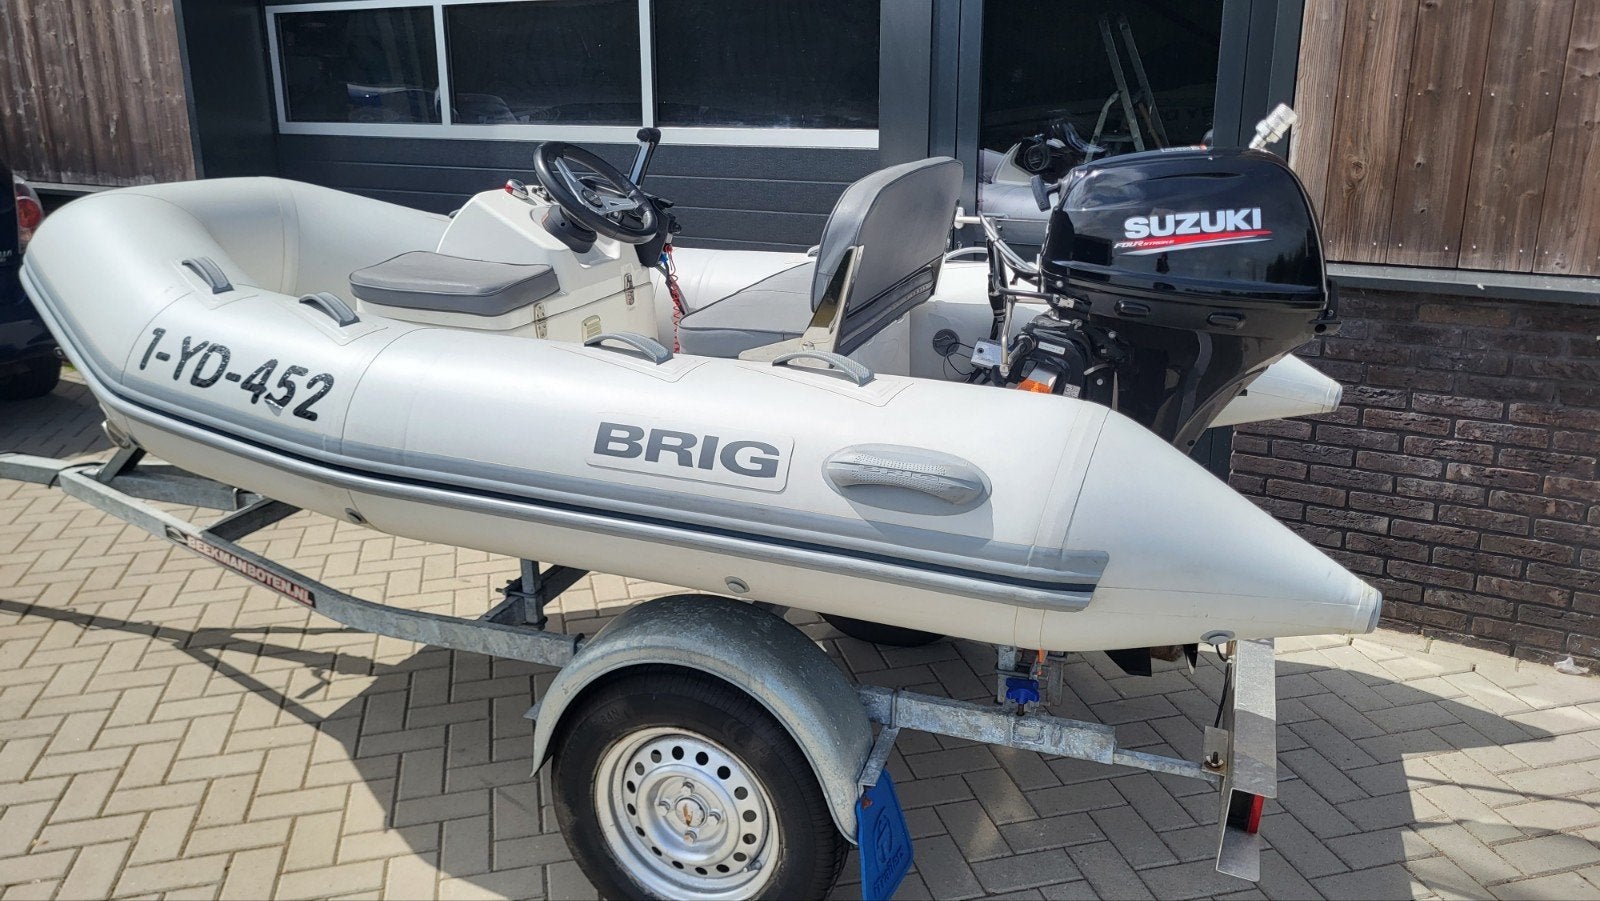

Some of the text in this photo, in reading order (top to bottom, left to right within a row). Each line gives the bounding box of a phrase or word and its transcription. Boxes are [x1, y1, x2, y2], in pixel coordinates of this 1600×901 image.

[1124, 207, 1262, 239] SUZUKI
[139, 327, 334, 421] 1-YD-452
[593, 421, 780, 478] BRIG
[186, 534, 313, 605] BEEKMANBOTEN.NL
